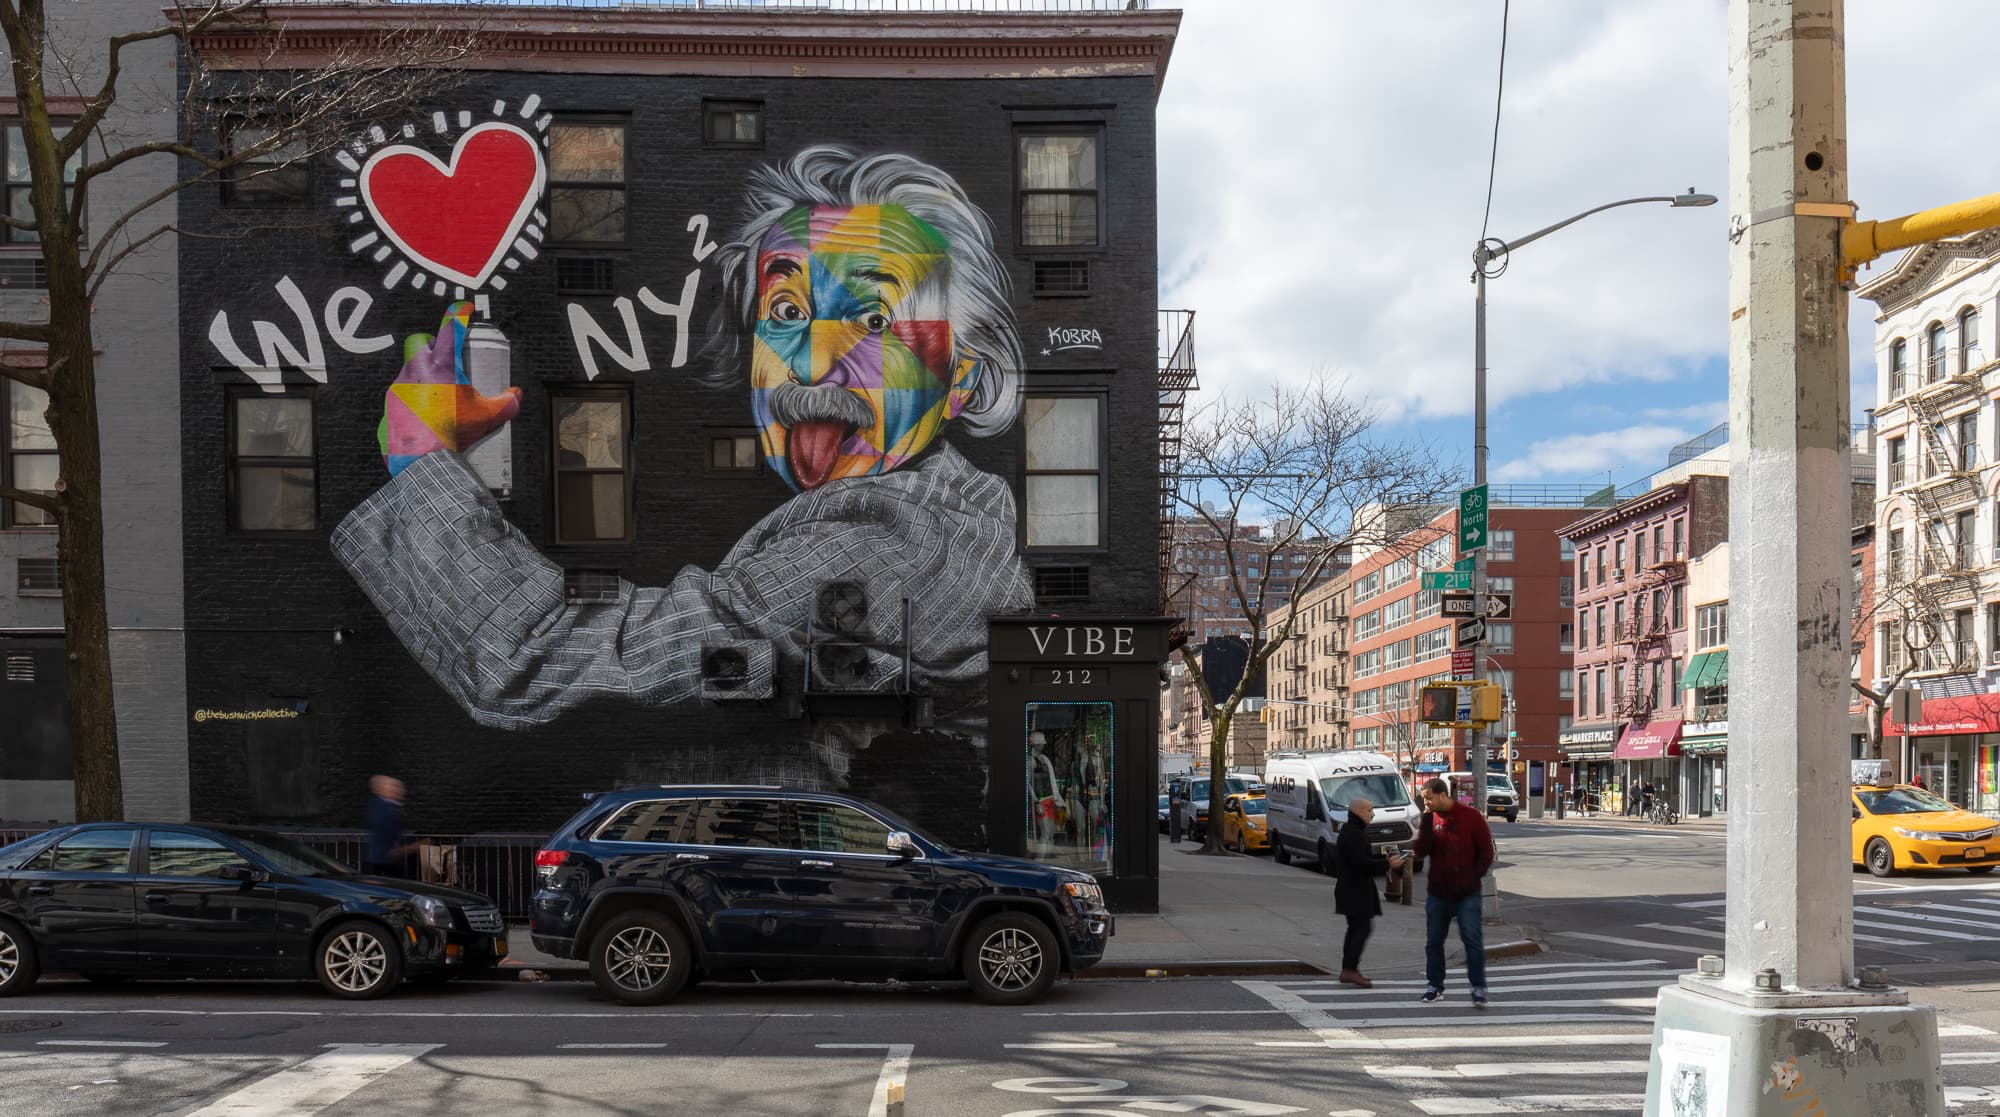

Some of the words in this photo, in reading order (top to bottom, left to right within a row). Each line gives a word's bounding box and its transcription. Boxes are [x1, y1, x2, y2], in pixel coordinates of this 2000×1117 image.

[208, 275, 395, 393] We
[1048, 326, 1102, 345] KOBRA
[1463, 512, 1484, 527] North
[1424, 574, 1436, 588] W
[1451, 601, 1471, 611] ONE
[1487, 602, 1500, 611] AY
[1028, 627, 1135, 656] VIBE
[1051, 669, 1091, 684] 212
[194, 708, 298, 721] @thebushwickcollective
[1466, 749, 1494, 760] RE
[1497, 749, 1519, 760] AD
[1332, 765, 1384, 775] AMP
[1271, 776, 1296, 794] AMP
